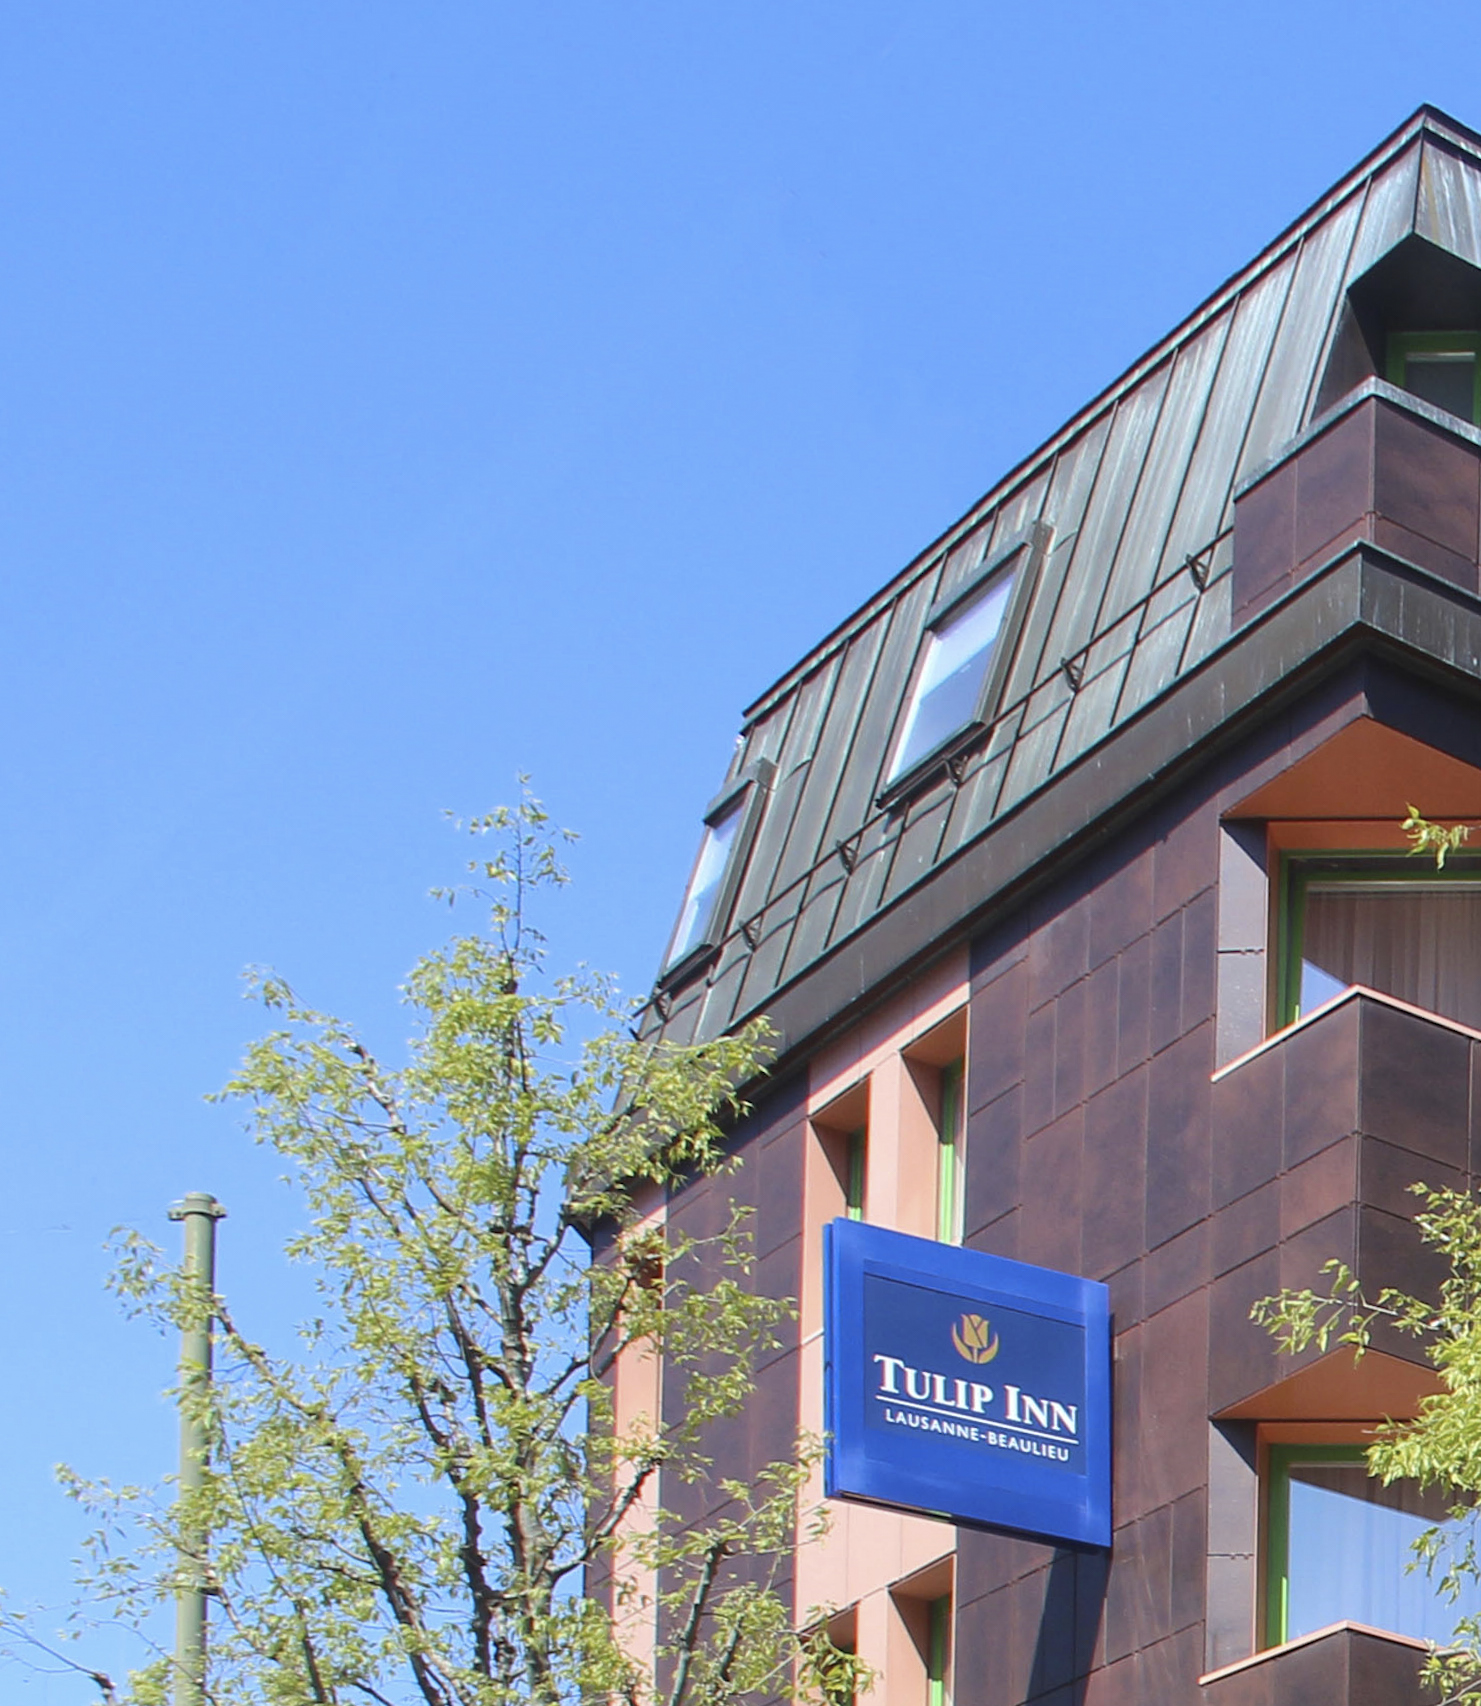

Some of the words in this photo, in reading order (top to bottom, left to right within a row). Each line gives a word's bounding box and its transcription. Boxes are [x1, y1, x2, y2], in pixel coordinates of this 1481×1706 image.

[873, 1353, 994, 1414] TULIP
[1003, 1384, 1078, 1435] INN
[885, 1408, 1069, 1462] LAUSANNE-BEAULIEU
